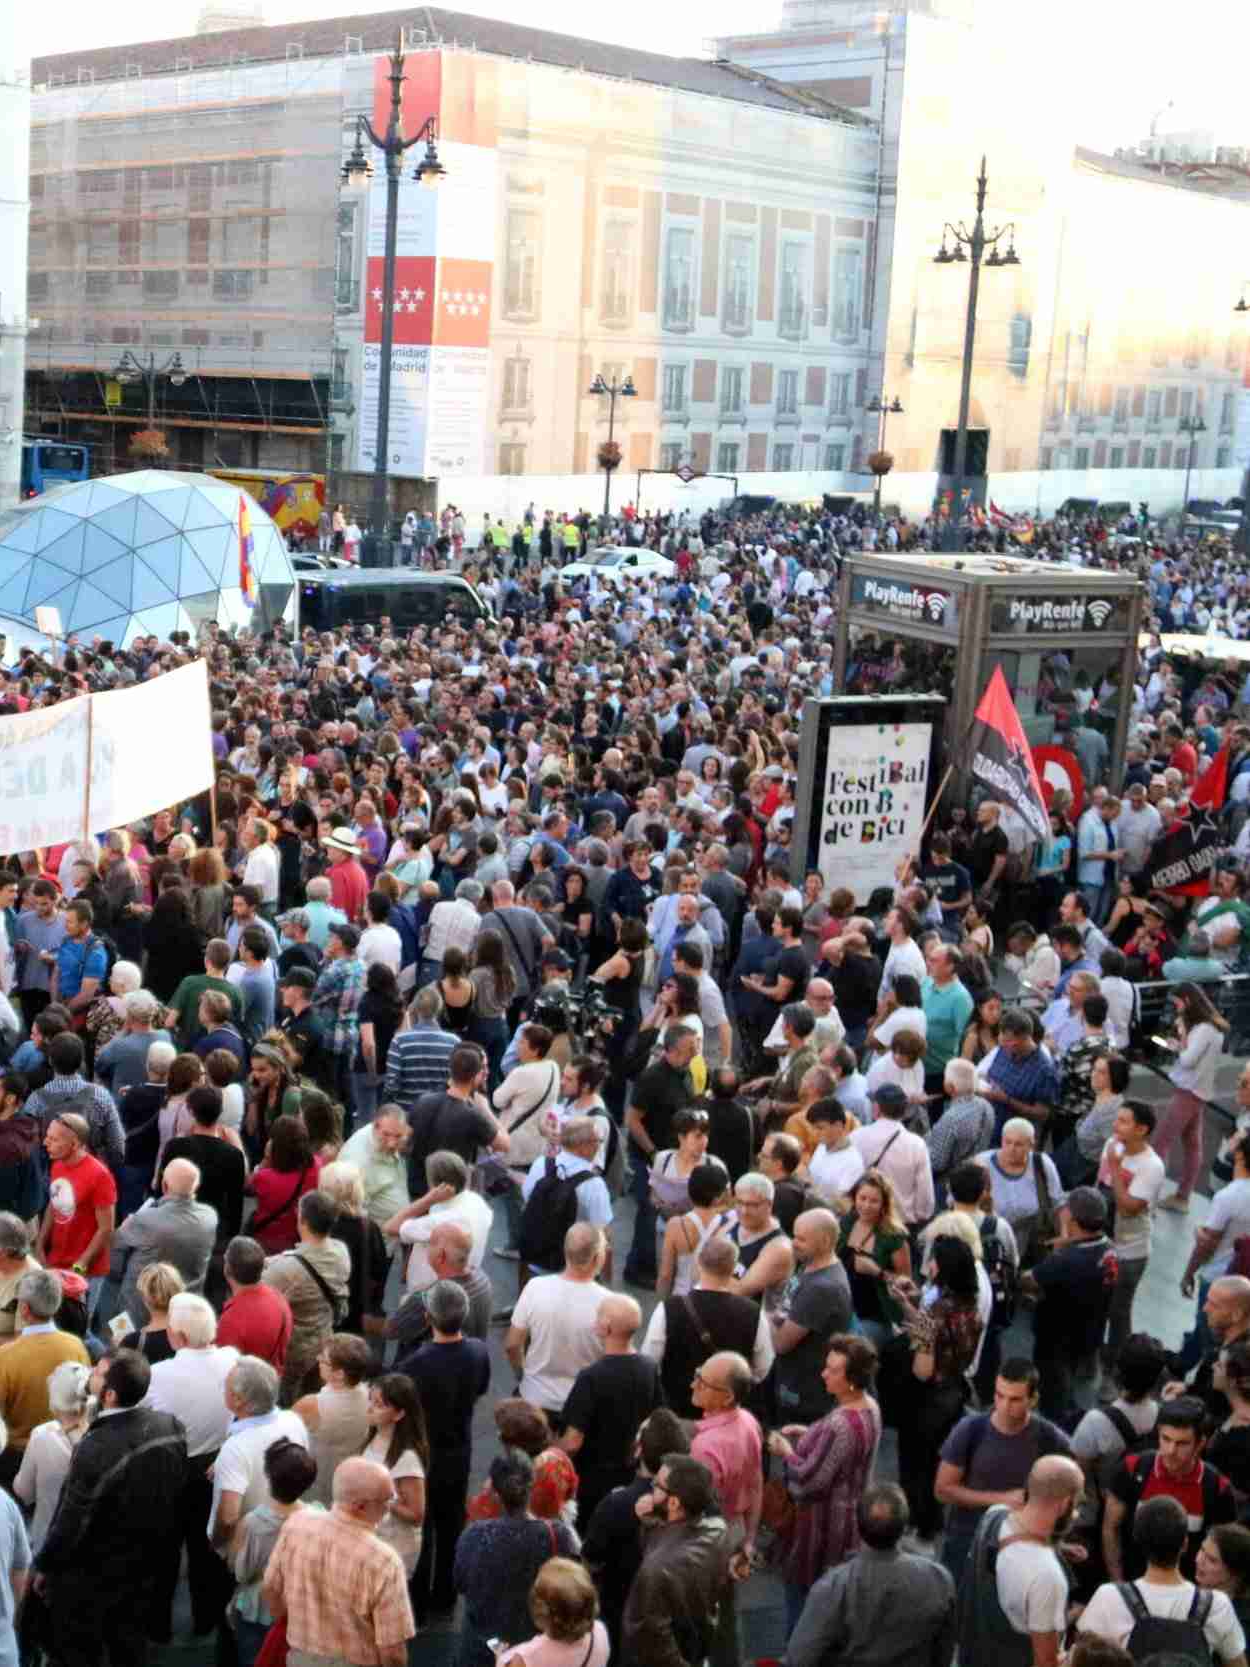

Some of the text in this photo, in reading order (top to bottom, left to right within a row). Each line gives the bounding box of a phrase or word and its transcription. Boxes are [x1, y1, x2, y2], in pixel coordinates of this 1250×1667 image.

[365, 346, 427, 358] Counidad
[864, 581, 925, 609] PlayRenfe
[1010, 600, 1086, 623] PlayRenfe
[829, 756, 926, 795] FestiBal
[826, 798, 868, 816] con
[823, 815, 905, 845] de Bici
